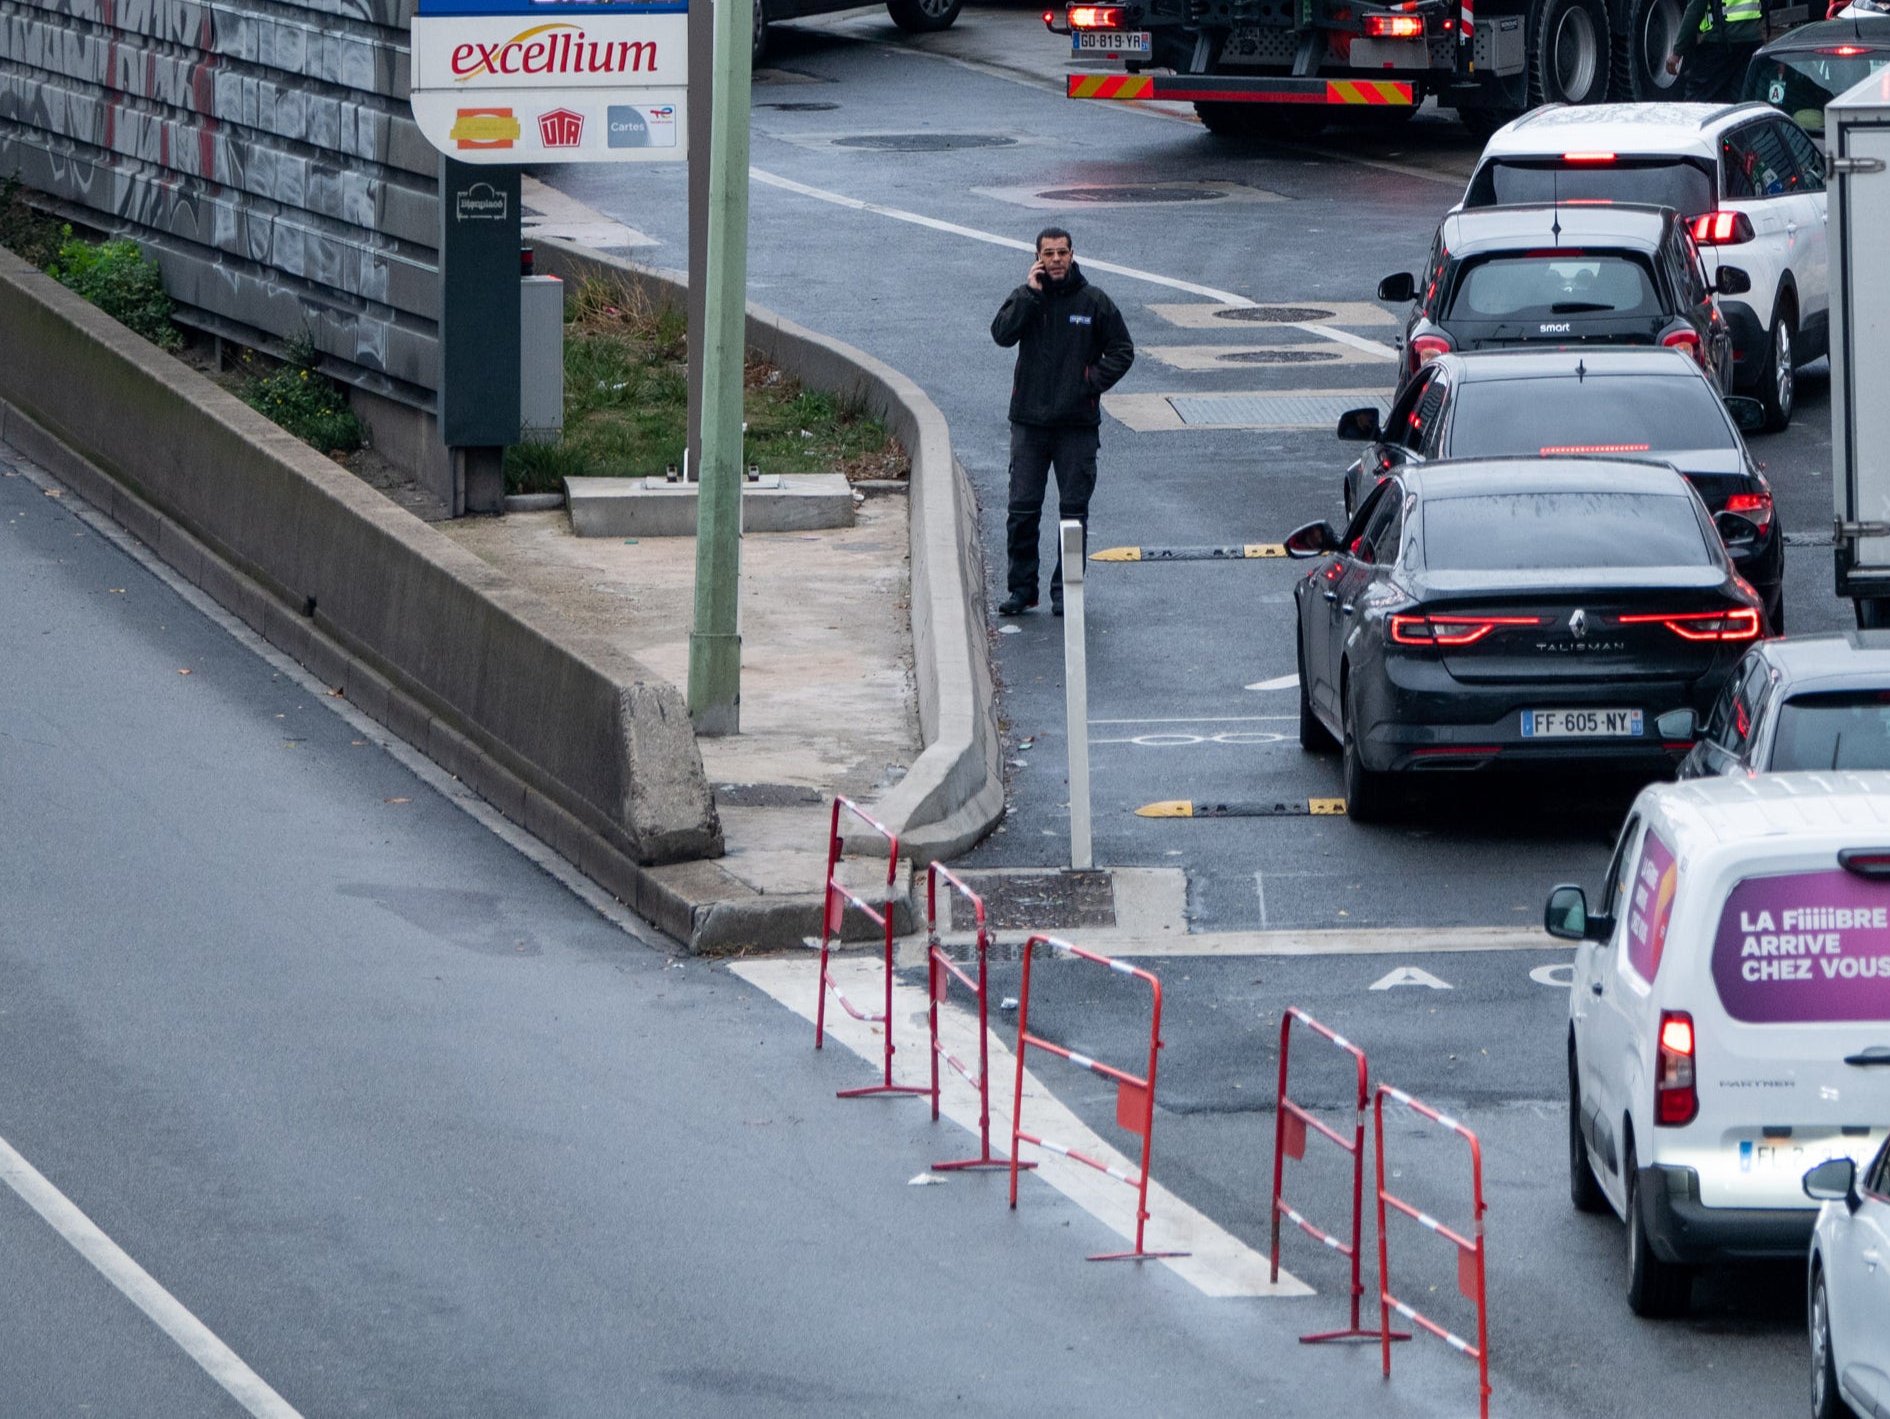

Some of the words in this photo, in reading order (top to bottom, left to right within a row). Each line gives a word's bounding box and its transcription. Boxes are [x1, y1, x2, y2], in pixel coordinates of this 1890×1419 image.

[451, 30, 658, 75] excellium
[1771, 87, 1780, 100] A
[541, 111, 582, 146] UTA
[611, 121, 645, 132] Cartes
[1540, 322, 1570, 332] smart
[1536, 641, 1625, 652] TALISMAN
[1535, 712, 1628, 733] FF-605-NY
[1741, 911, 1776, 932] LA
[1741, 933, 1841, 957] ARRIVE
[1742, 959, 1813, 981] CHEZ
